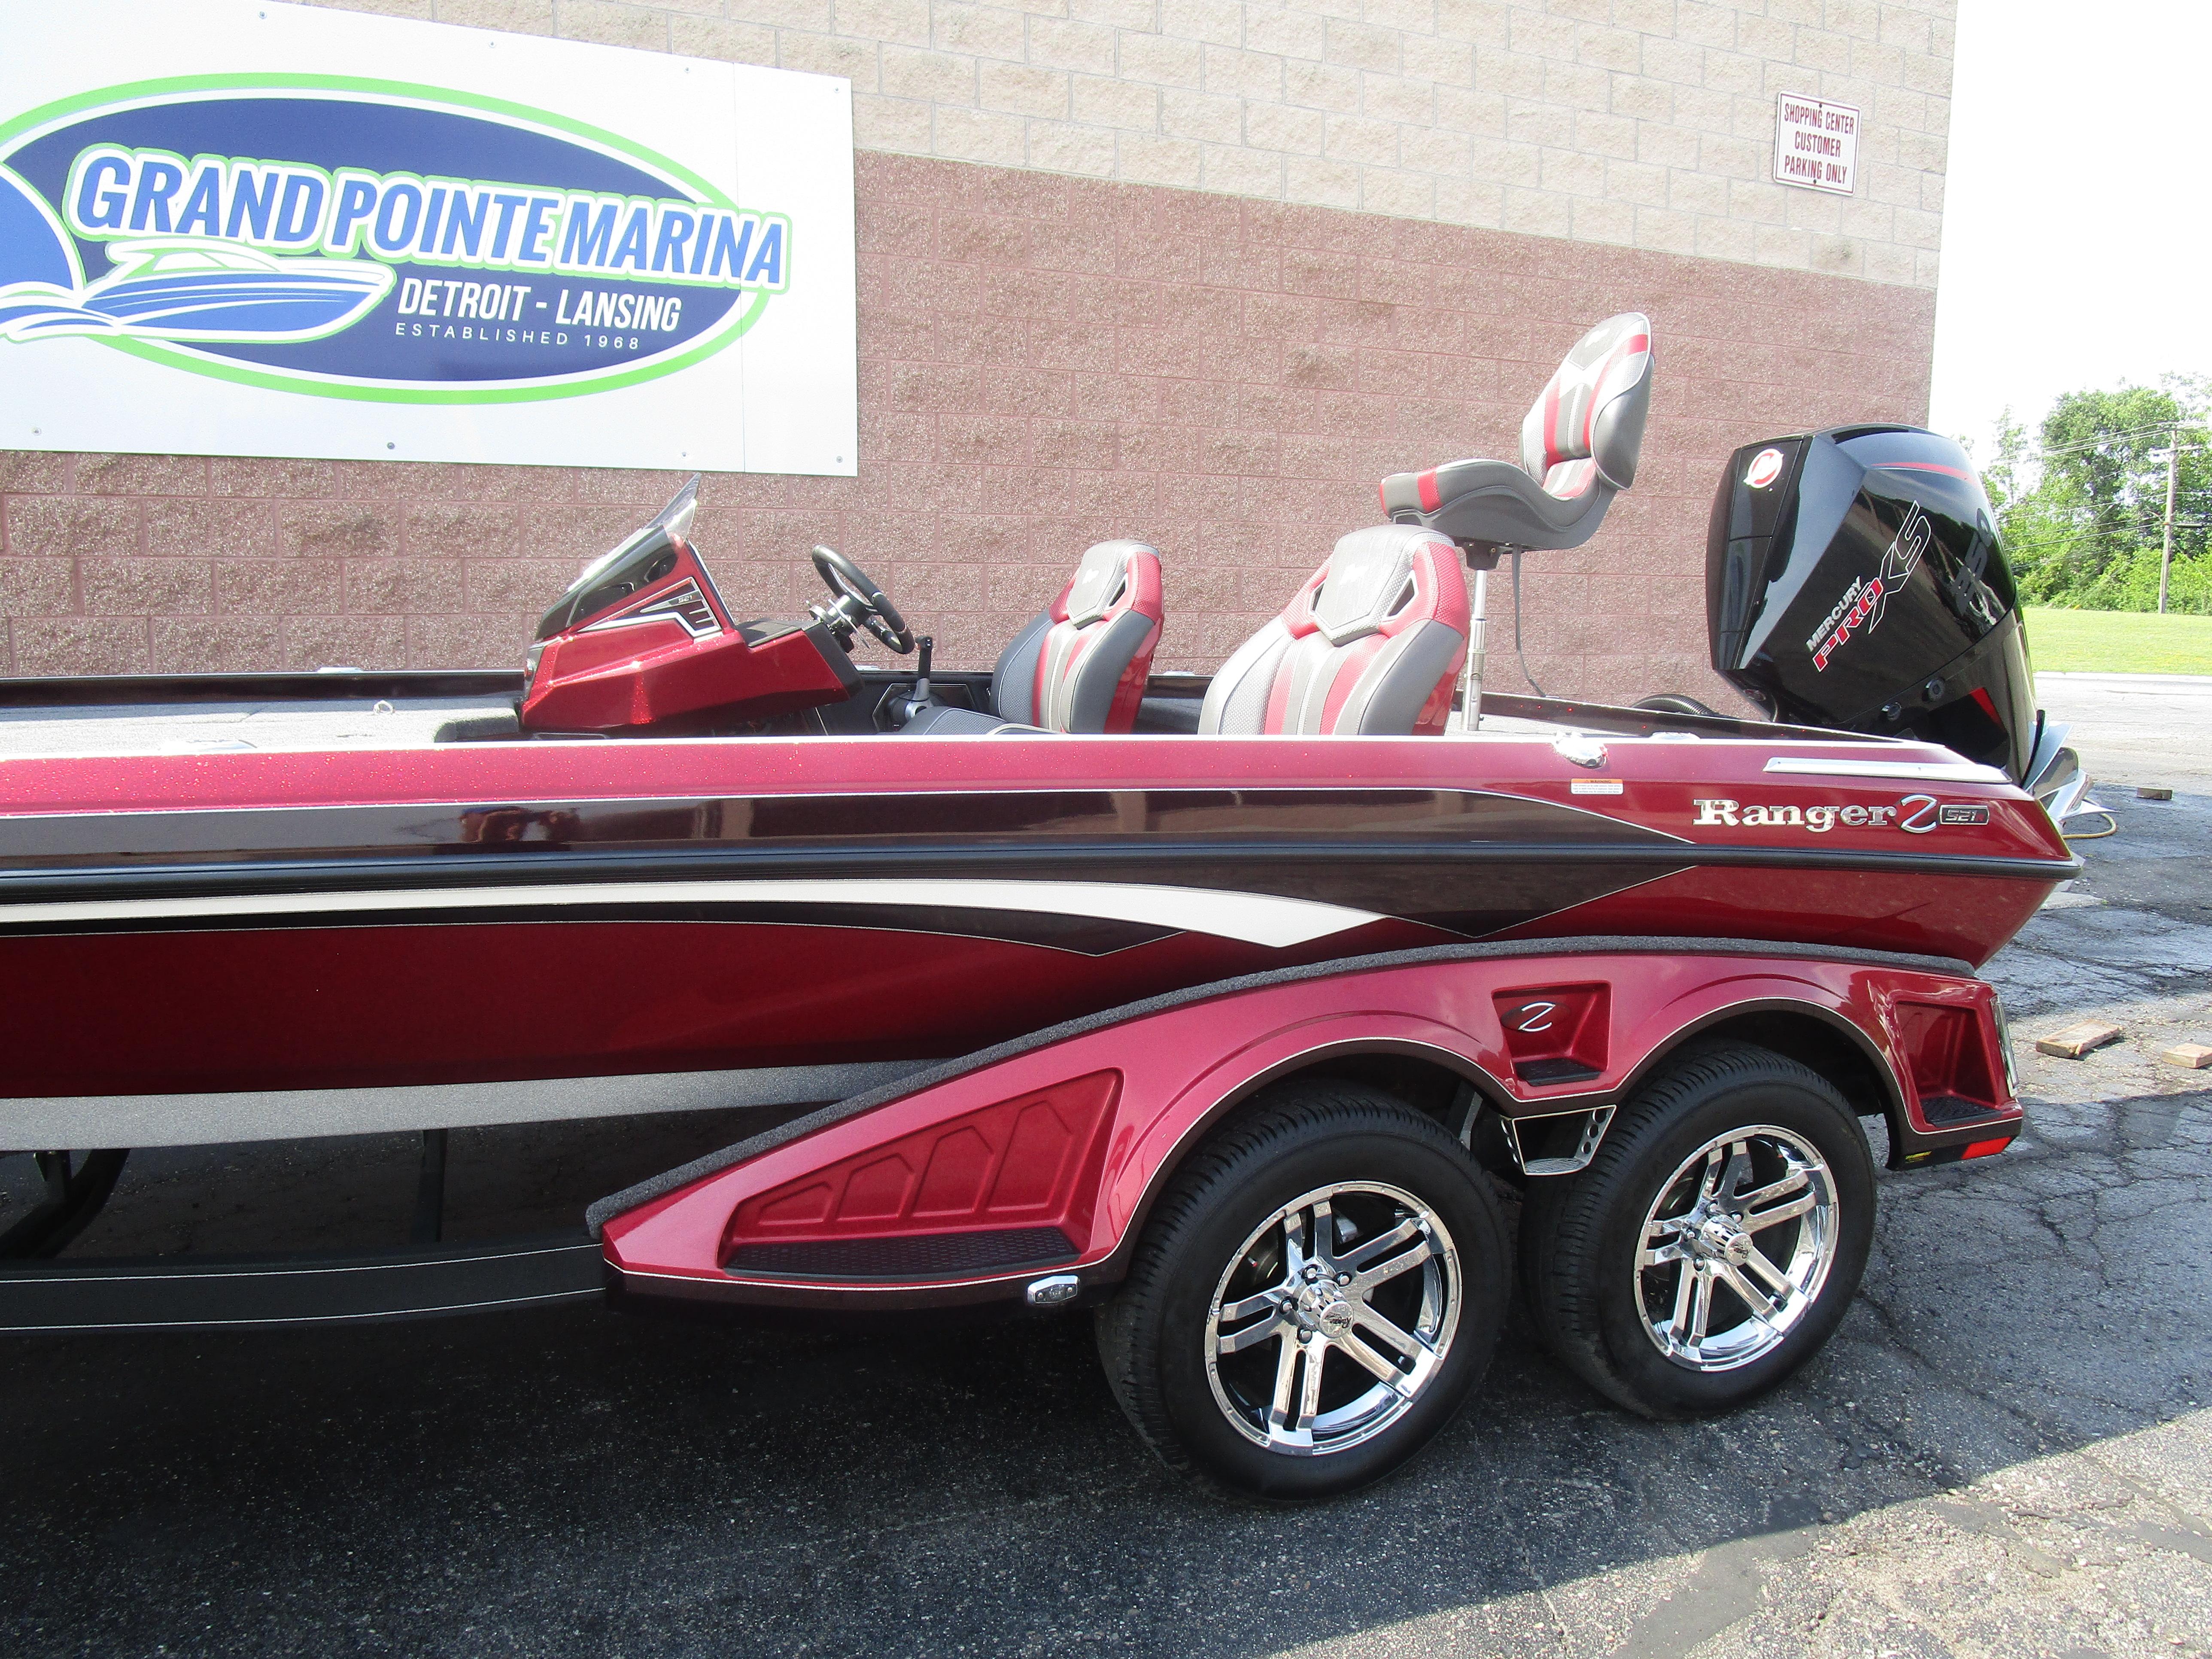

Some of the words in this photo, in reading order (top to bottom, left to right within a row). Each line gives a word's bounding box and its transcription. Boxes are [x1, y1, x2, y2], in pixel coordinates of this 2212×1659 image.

[1784, 103, 1823, 128] SHOPPING
[1826, 111, 1854, 135] CENTER
[1794, 131, 1841, 157] CUSTOMER
[1784, 155, 1823, 179] PARKING
[1826, 163, 1847, 184] ONLY
[76, 155, 325, 243] GRAND
[331, 179, 559, 263] POINTE
[559, 200, 783, 285] MARINA
[397, 277, 531, 321] DETROIT
[555, 289, 682, 331] LANSING
[395, 323, 568, 344] ESTABLISHED
[584, 334, 640, 349] 1968
[1806, 576, 1863, 652] MERCURY
[1693, 799, 1897, 833] Ranger
